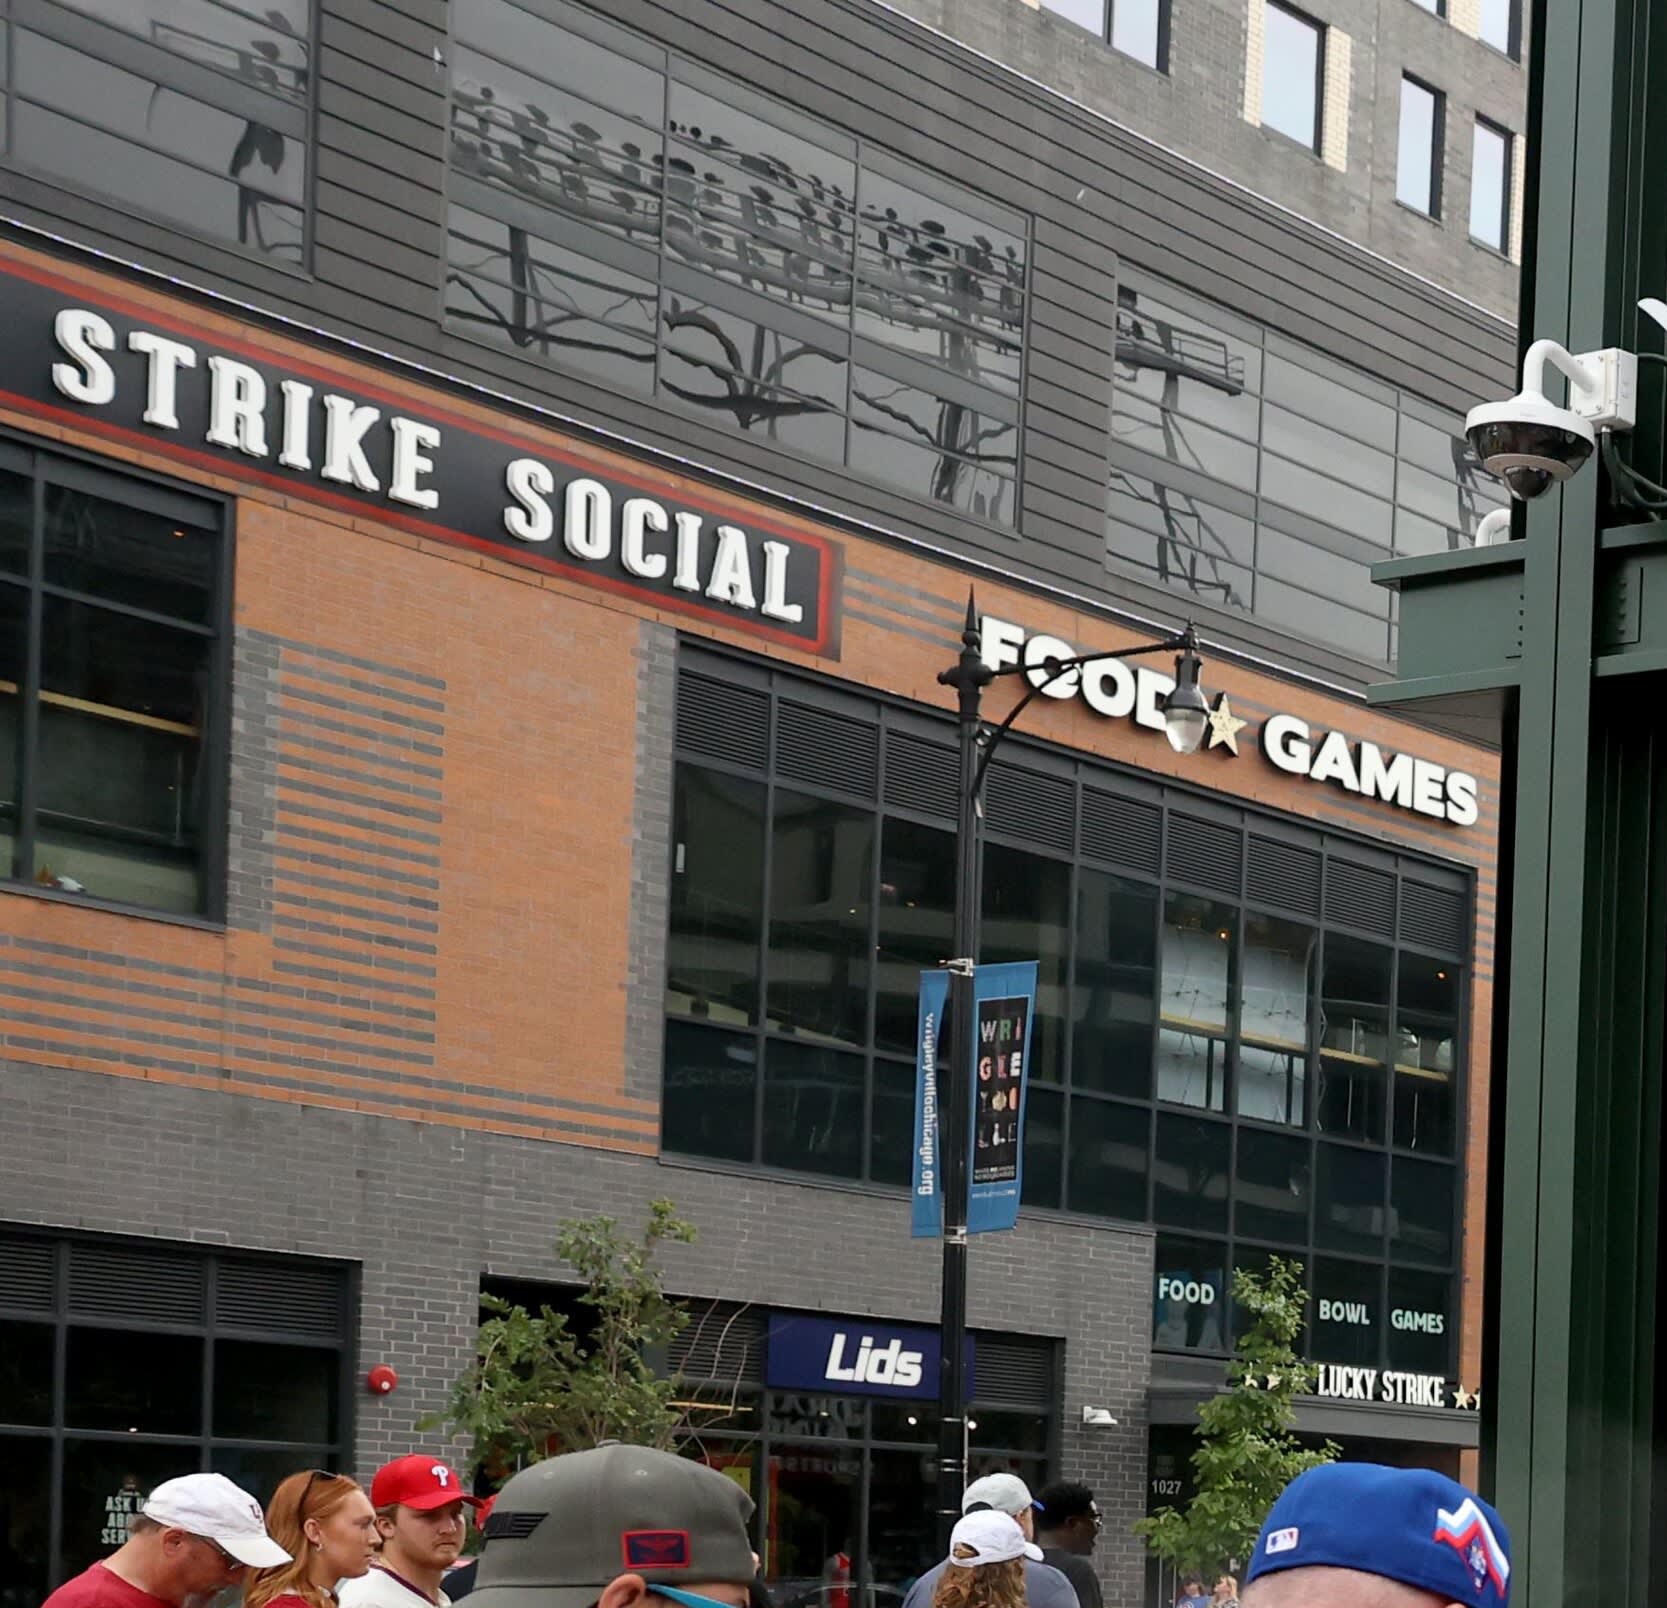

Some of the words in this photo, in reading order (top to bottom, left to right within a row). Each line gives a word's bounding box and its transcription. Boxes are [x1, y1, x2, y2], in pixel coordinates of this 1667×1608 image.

[52, 308, 441, 510] STRIKE
[503, 457, 803, 624] SOCIAL
[980, 615, 1175, 735] FOOD
[1264, 714, 1479, 828] GAMES
[1158, 1276, 1216, 1305] FOOD
[1318, 1298, 1371, 1326] BOWL
[1391, 1308, 1445, 1335] GAMES
[825, 1332, 923, 1387] Lids
[1317, 1363, 1378, 1401] LUCKY
[1382, 1371, 1446, 1408] STRIKE
[104, 1495, 132, 1512] ASK
[1151, 1479, 1183, 1496] 1027
